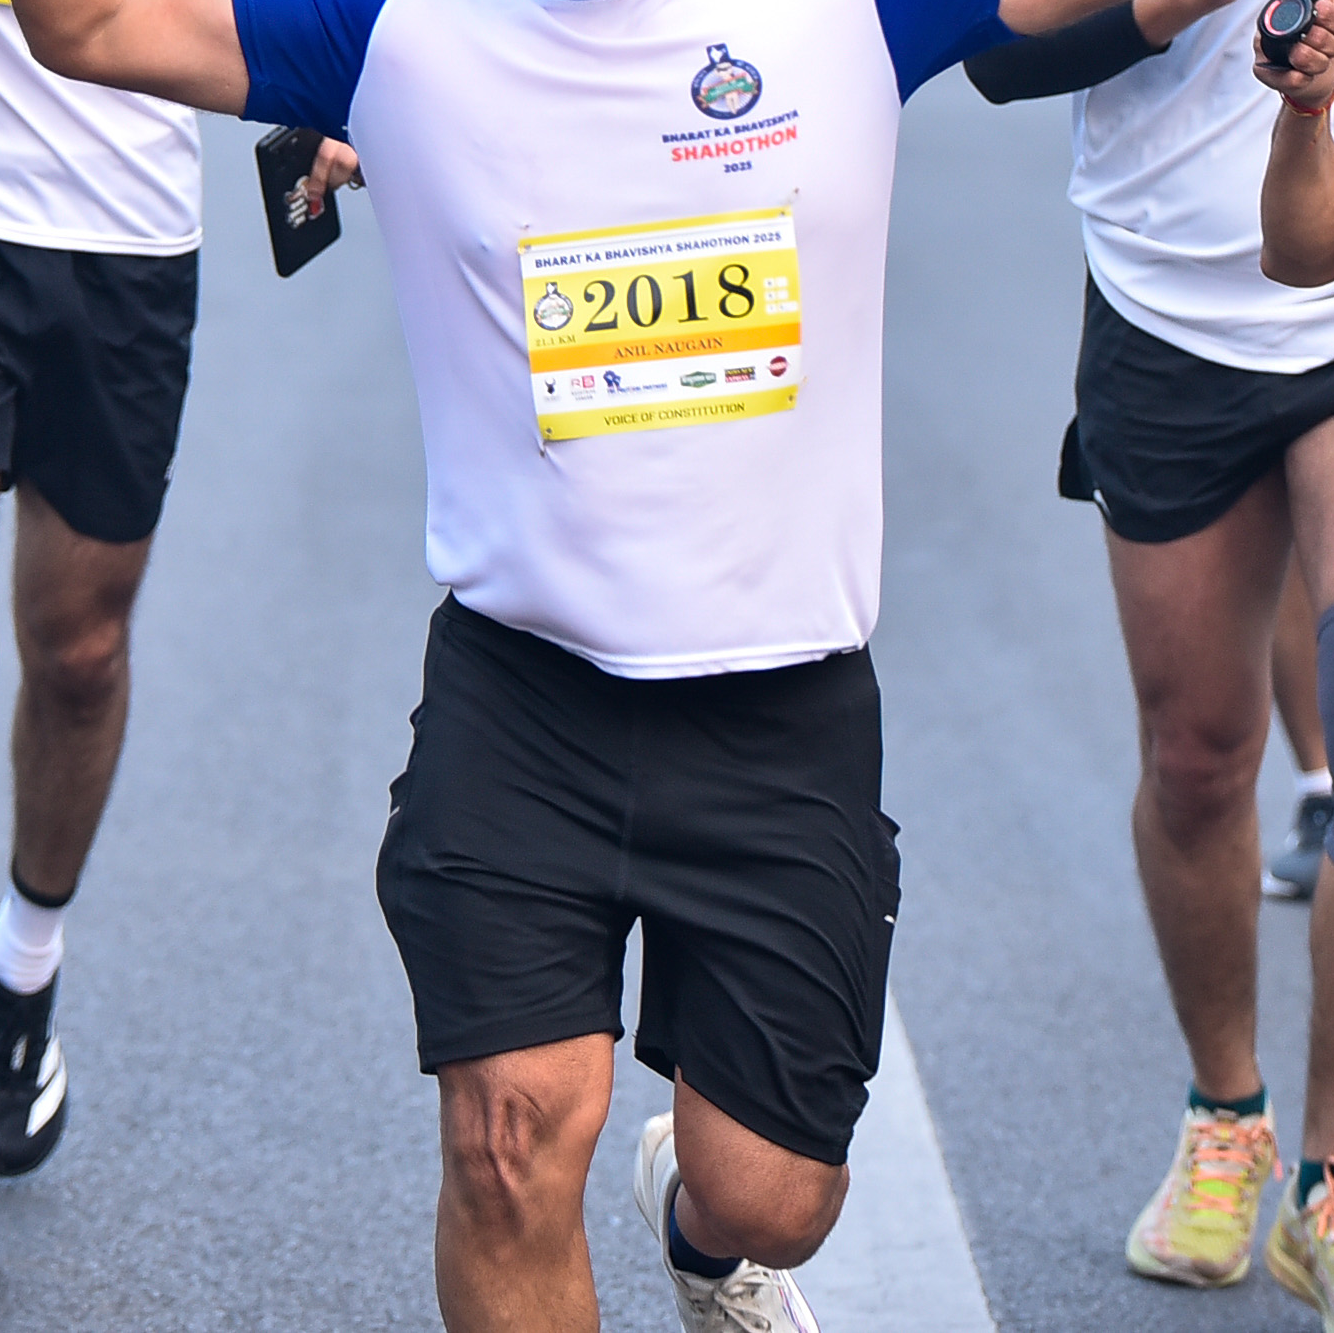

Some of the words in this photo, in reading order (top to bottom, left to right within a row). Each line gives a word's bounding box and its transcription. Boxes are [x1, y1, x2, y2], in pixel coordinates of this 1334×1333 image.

[662, 129, 712, 143] BHARAT
[714, 127, 731, 137] KA
[734, 109, 799, 134] BHAVISHYA
[671, 125, 798, 162] SHAHOTHON
[535, 253, 582, 269] BHARAT
[585, 251, 602, 263] KA
[605, 243, 673, 260] BHAVISHYA
[676, 235, 750, 252] SHAHOTHON
[753, 231, 782, 243] 2025
[583, 263, 756, 333] 2018
[558, 334, 576, 345] KM
[614, 344, 651, 359] ANIL
[655, 337, 723, 355] NAUGAIN
[604, 413, 638, 427] VOICE
[641, 411, 654, 422] OF
[659, 402, 746, 420] CONSTITUTION
